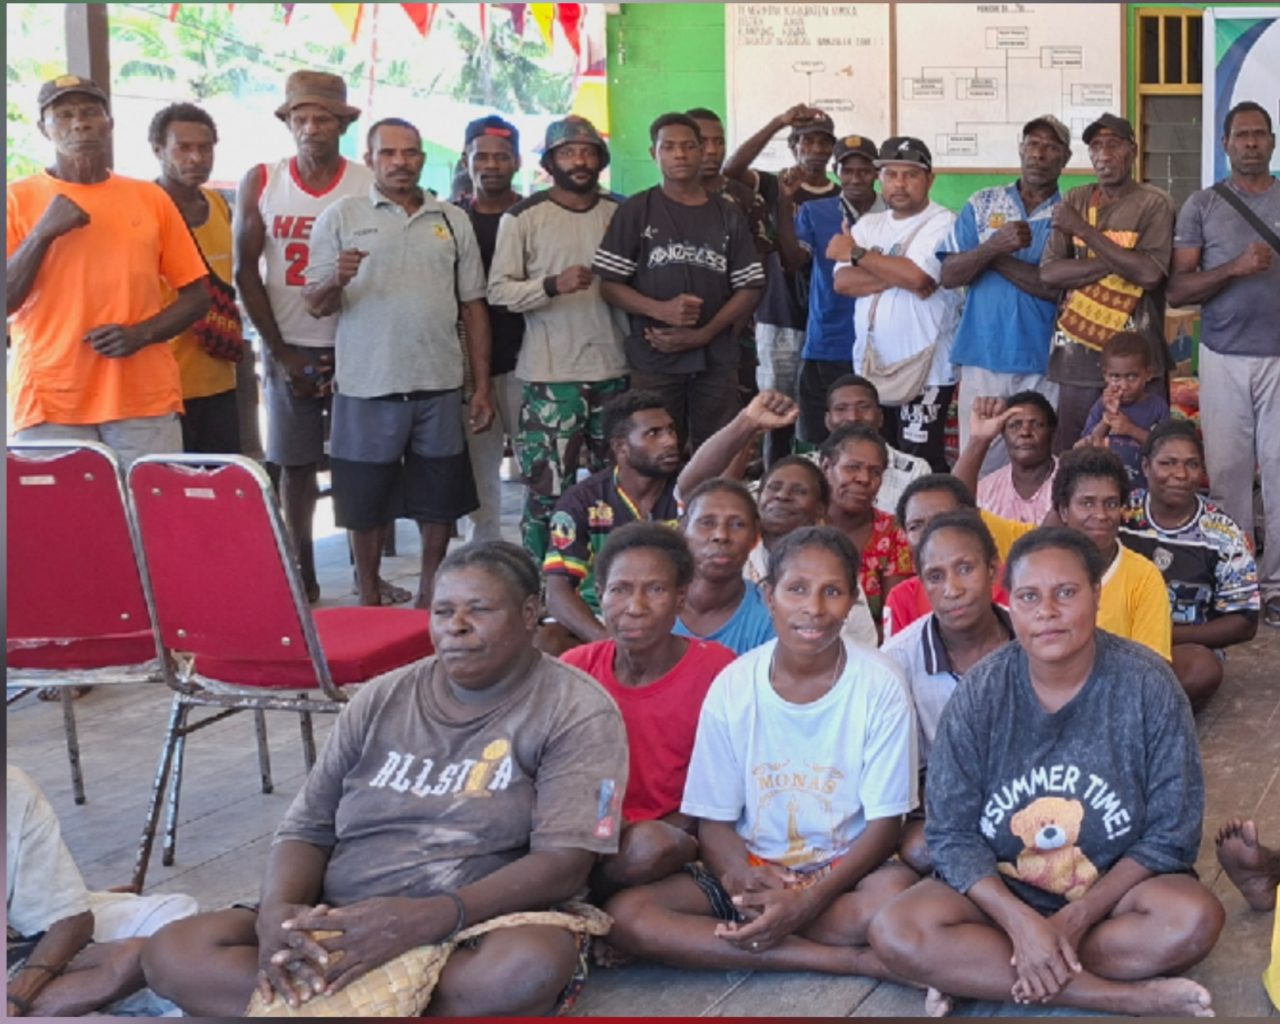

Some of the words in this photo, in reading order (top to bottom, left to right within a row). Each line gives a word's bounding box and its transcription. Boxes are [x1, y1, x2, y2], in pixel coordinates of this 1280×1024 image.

[758, 772, 838, 795] MONAS
[979, 764, 1082, 840] #SUMMER
[1081, 773, 1131, 841] TIME!
